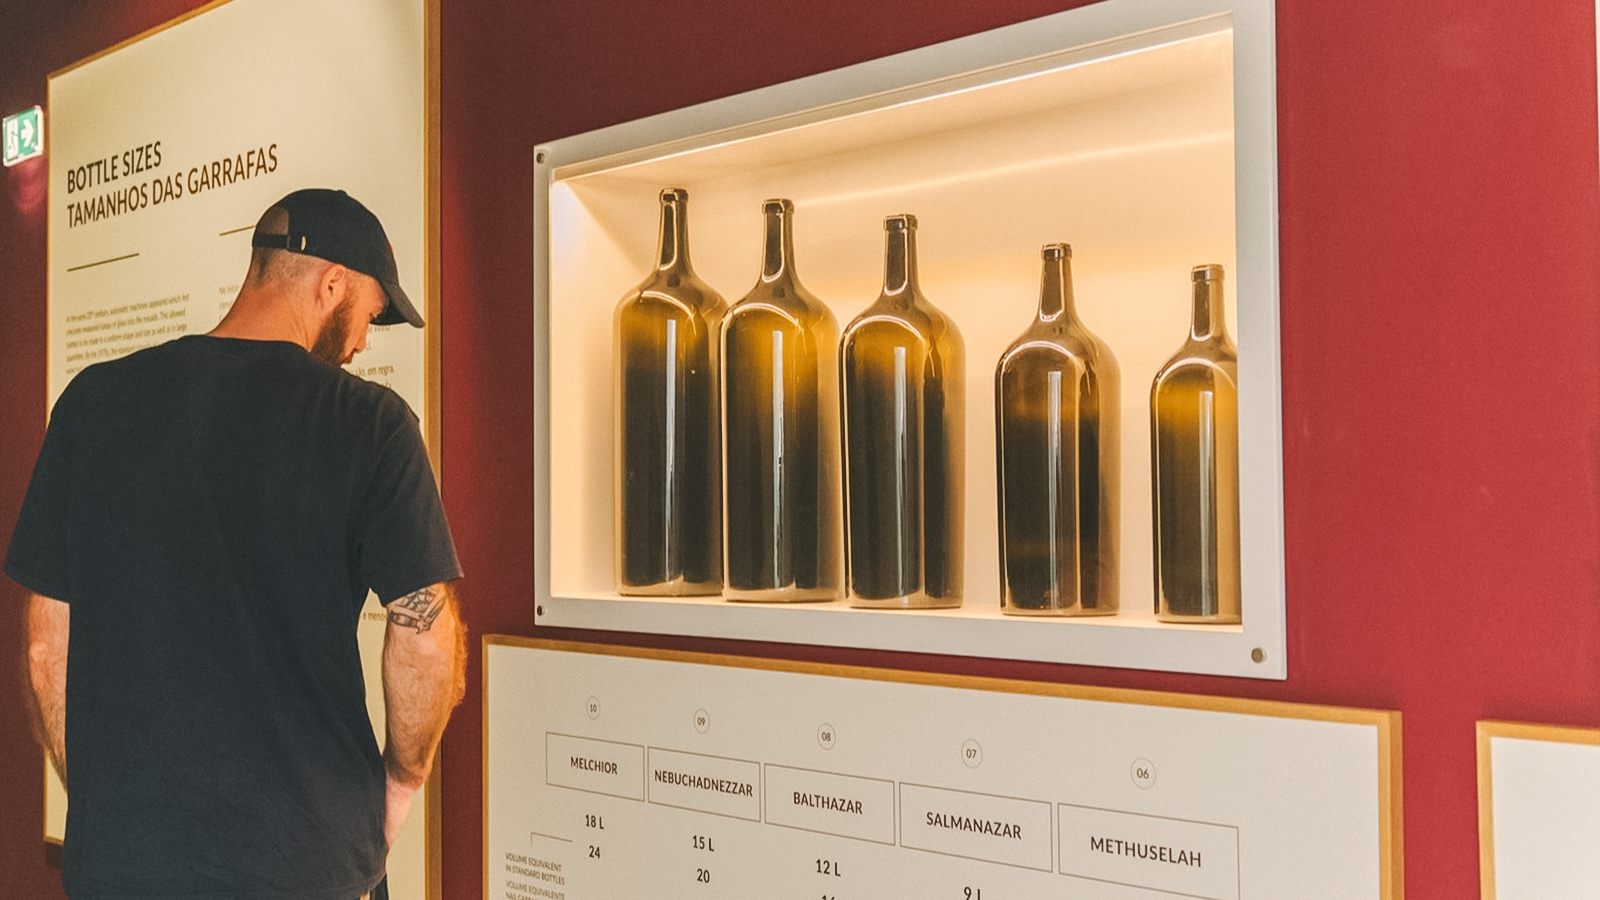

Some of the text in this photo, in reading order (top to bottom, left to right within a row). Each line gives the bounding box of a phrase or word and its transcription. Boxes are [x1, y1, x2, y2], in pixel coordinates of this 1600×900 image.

[67, 141, 162, 194] BOTTLE SIZES
[67, 143, 279, 229] TAMANHOS DAS GARRAFAS
[590, 704, 598, 713] 10
[697, 717, 706, 726] 09
[821, 731, 831, 742] 08
[966, 748, 977, 759] 07
[570, 756, 618, 776] MELCHIOR
[1136, 767, 1150, 780] 06
[654, 769, 753, 798] NEBUCHADNEZZAR
[793, 791, 863, 815] BALTHAZAR
[585, 814, 605, 830] 18 L
[926, 811, 1022, 840] SALMANAZAR
[588, 845, 601, 859] 24
[692, 835, 715, 852] 15 L
[1090, 836, 1202, 868] METHUSELAH
[505, 851, 562, 872] VOLUME EQUIVALENT
[815, 858, 842, 877] 12 L
[512, 865, 541, 879] STANDARD
[541, 872, 565, 886] BOTTLES
[696, 868, 710, 884] 20
[505, 880, 527, 892] VOLUME
